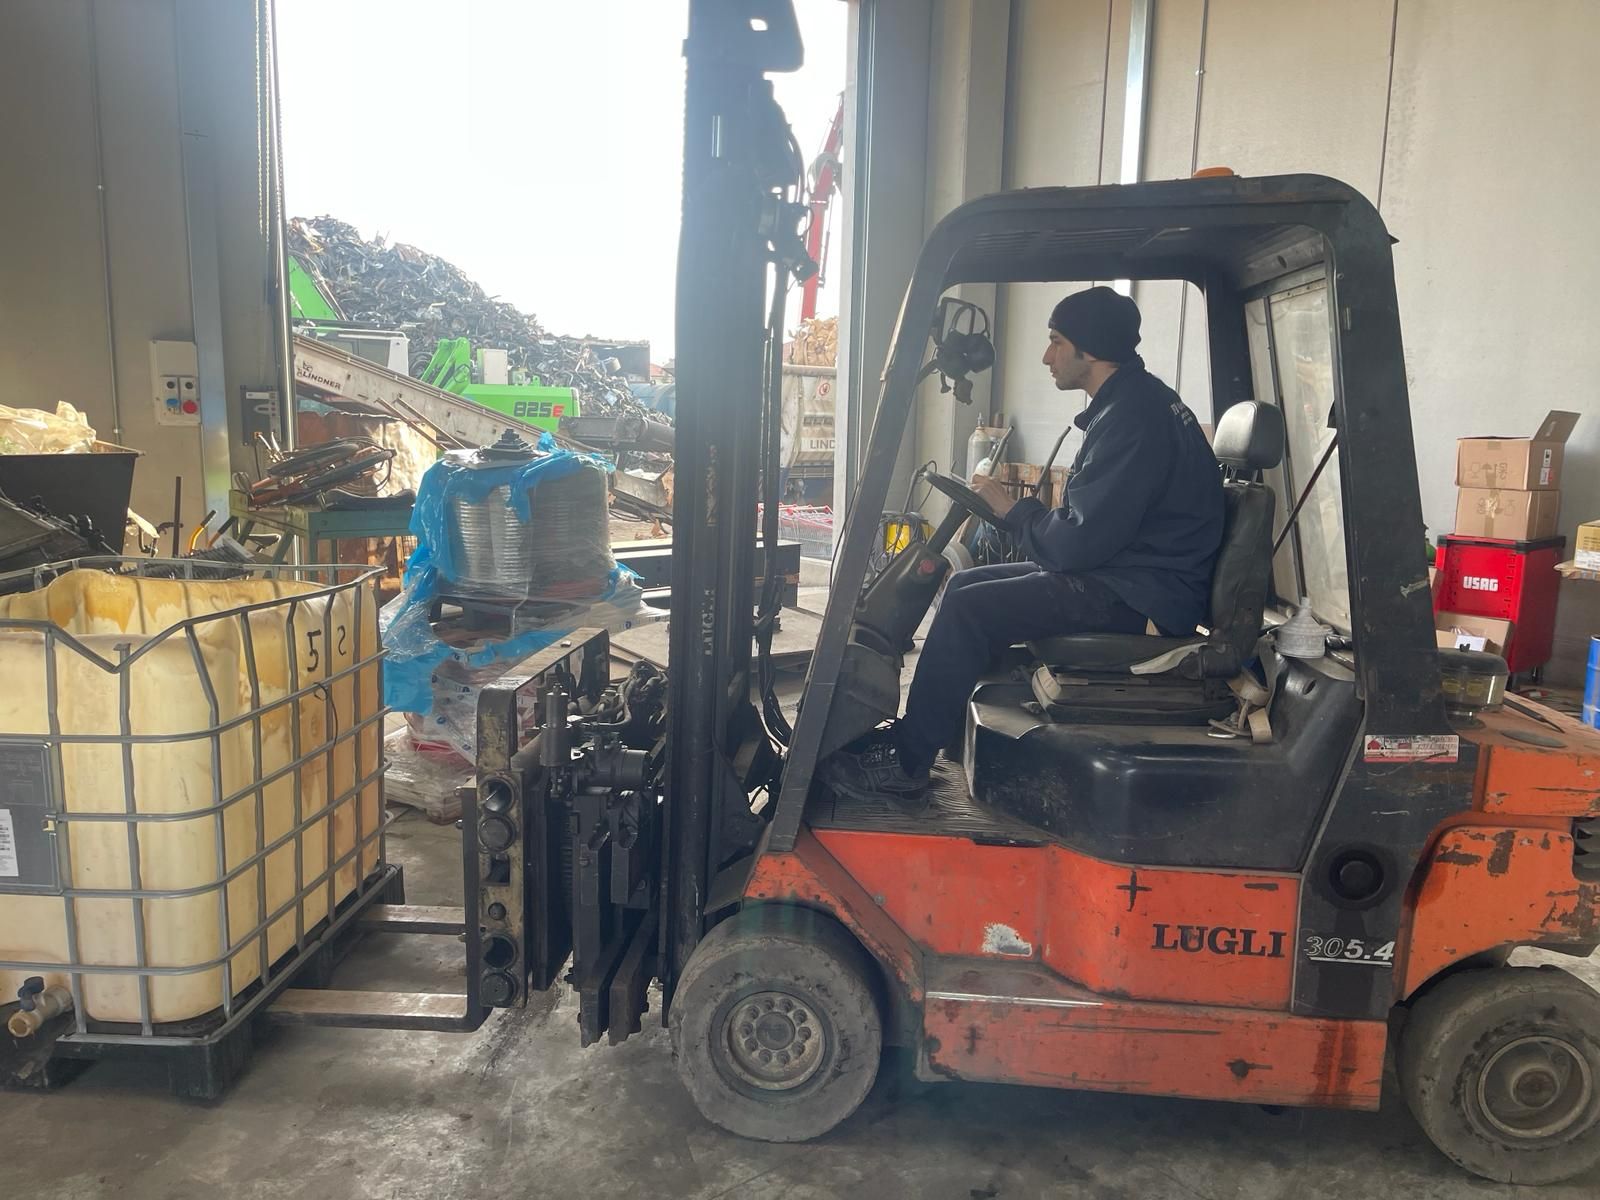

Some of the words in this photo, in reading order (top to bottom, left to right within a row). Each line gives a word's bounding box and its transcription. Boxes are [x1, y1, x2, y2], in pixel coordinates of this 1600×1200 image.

[303, 371, 341, 389] LINDNER
[513, 401, 565, 418] 825E
[1463, 576, 1499, 592] USAG
[1151, 923, 1287, 958] LUGLI
[1303, 935, 1396, 961] 305.4
